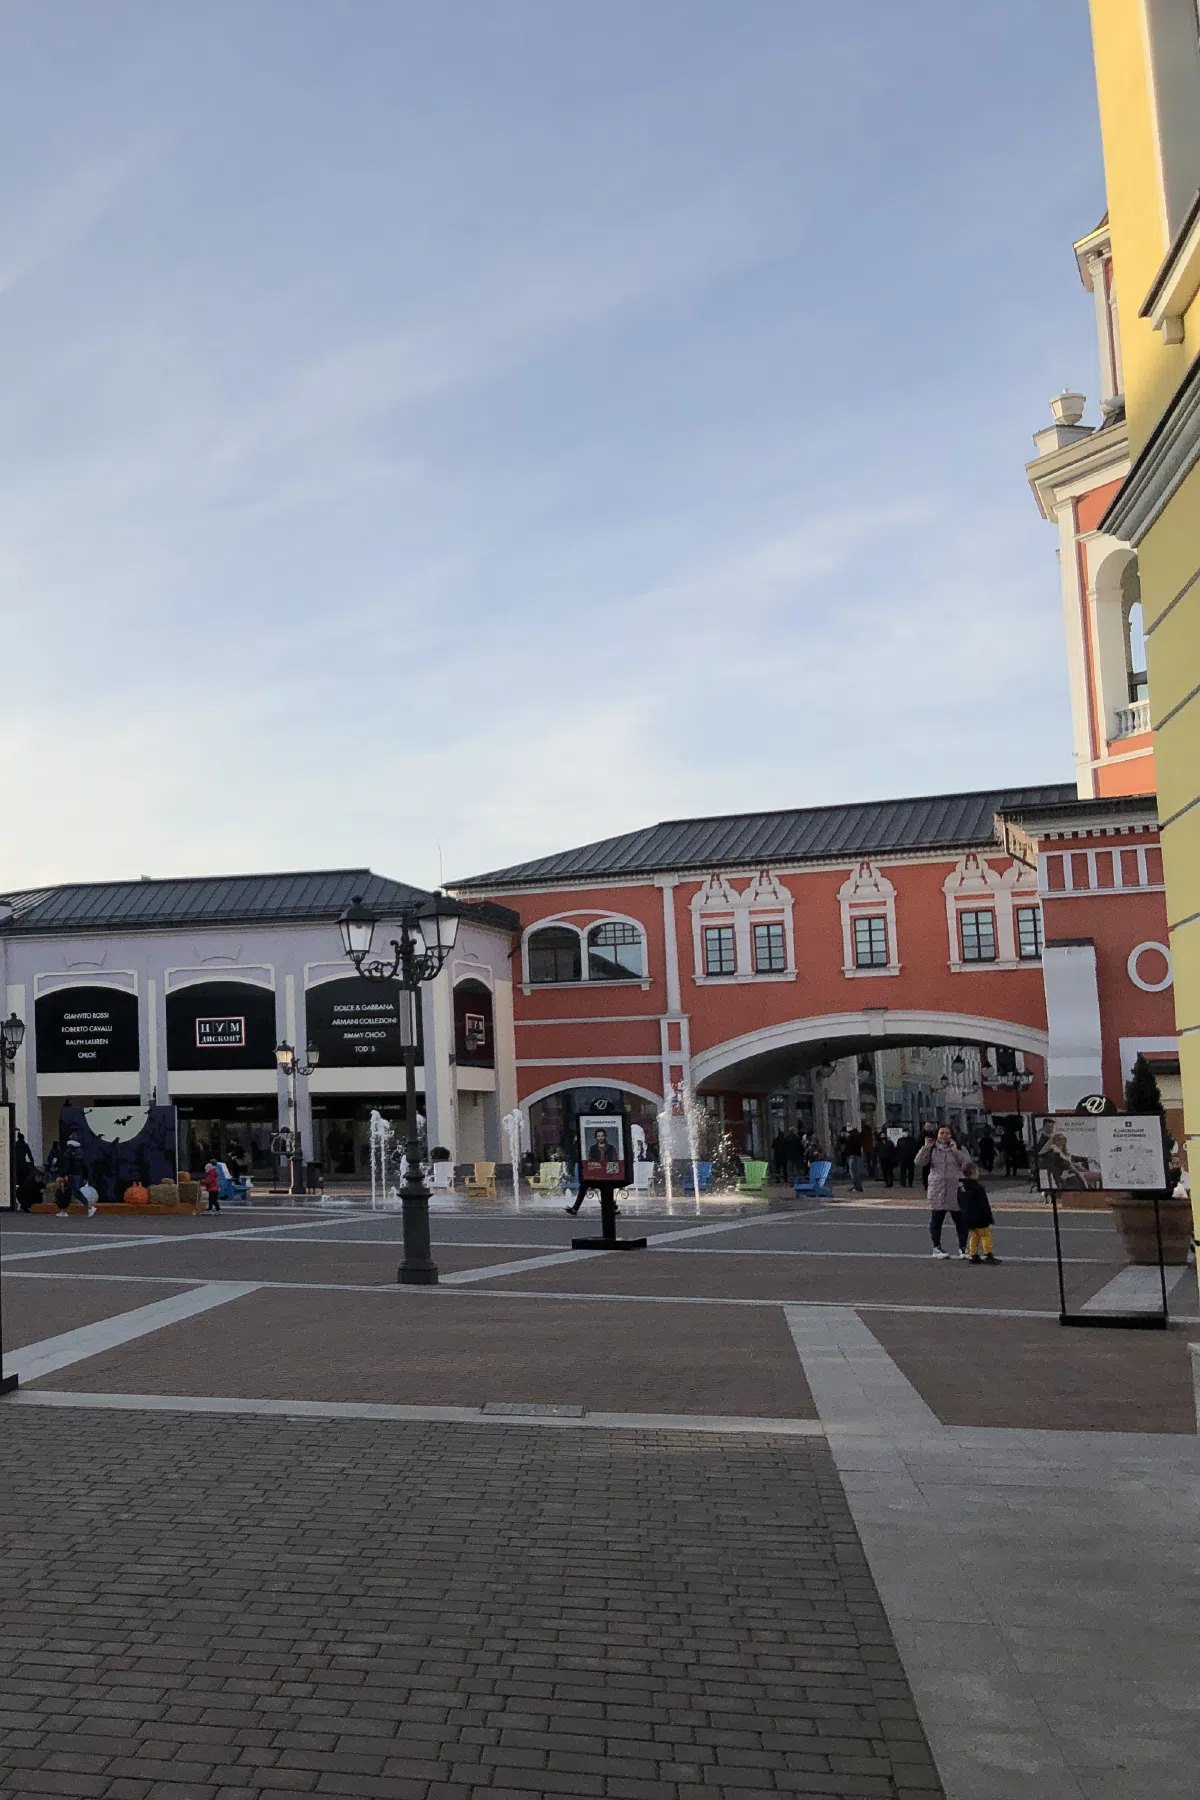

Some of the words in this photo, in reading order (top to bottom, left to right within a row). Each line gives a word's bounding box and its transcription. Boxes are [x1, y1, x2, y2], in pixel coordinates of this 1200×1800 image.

[334, 1004, 355, 1012] DOLCE
[361, 1003, 394, 1011] GABBANA
[63, 1012, 92, 1020] GIANVITO
[200, 1022, 240, 1033] ЦУМ
[200, 1034, 241, 1043] ДИСКОНТ
